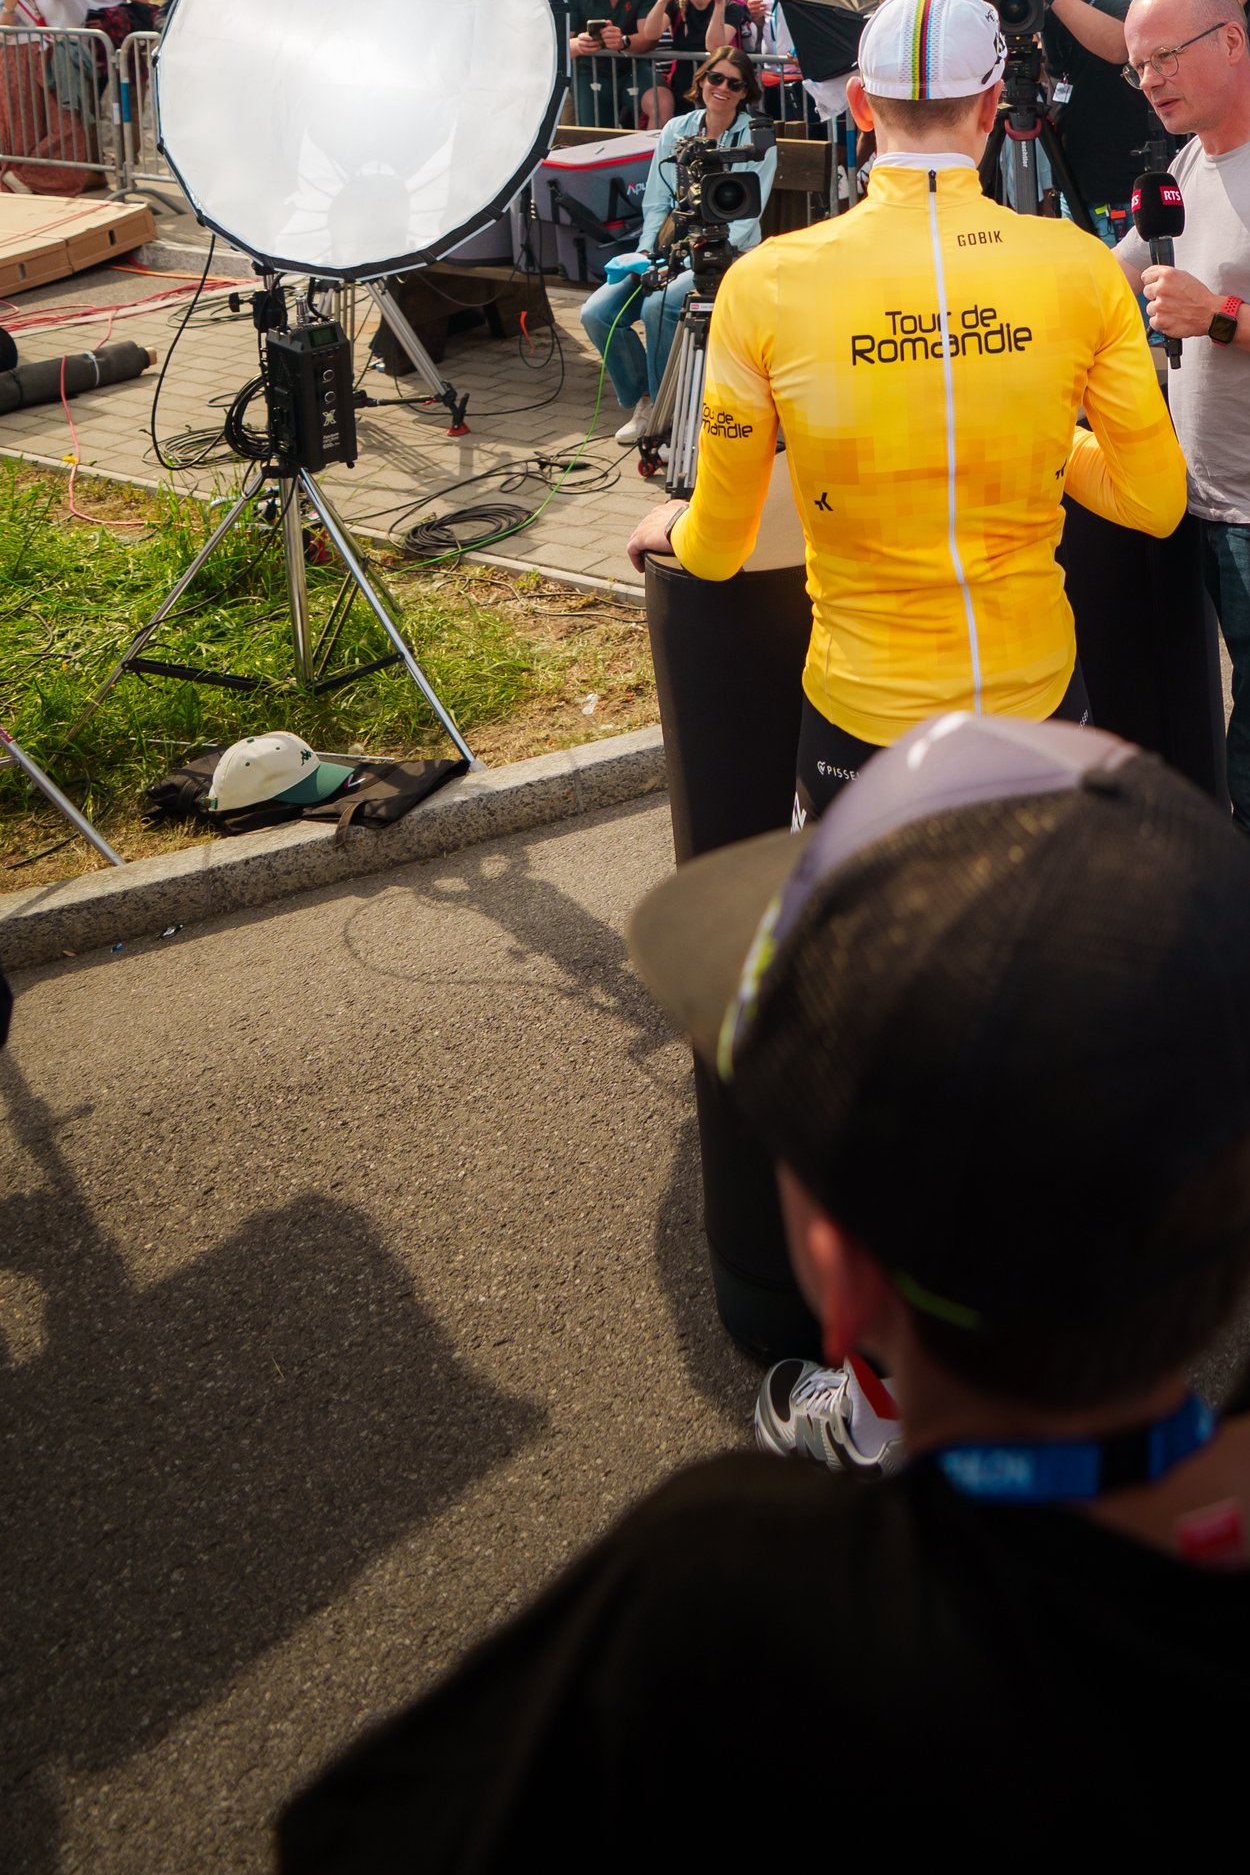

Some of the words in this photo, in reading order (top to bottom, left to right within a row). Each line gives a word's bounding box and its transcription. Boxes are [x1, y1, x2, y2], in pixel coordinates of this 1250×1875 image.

[626, 180, 647, 196] Apu
[1163, 190, 1181, 201] RTS
[957, 230, 1003, 247] GOBIK
[884, 310, 952, 336] Tour
[961, 304, 997, 330] de
[851, 322, 1033, 366] Romandie
[716, 411, 734, 425] de
[702, 418, 753, 439] mandie
